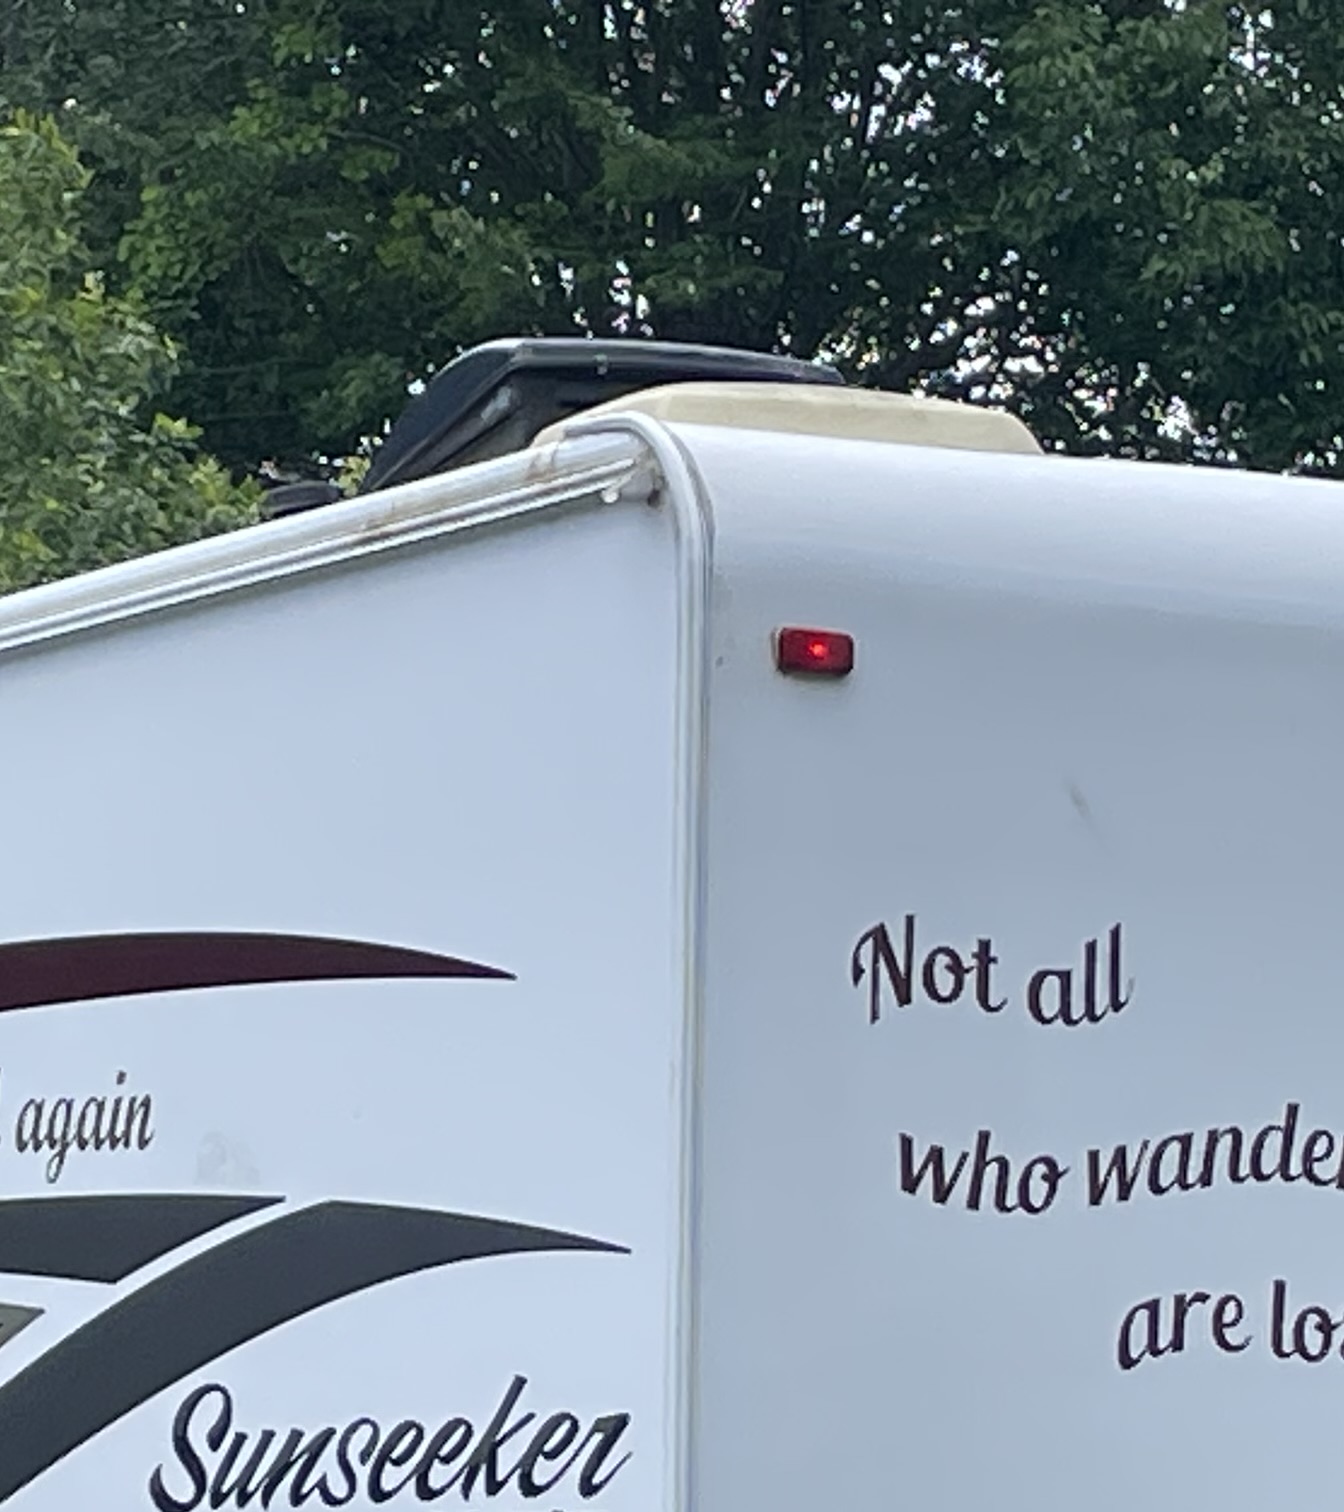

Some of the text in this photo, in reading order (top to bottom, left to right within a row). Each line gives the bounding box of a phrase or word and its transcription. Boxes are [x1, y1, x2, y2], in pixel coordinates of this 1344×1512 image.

[851, 914, 1134, 1027] Not all
[15, 1070, 154, 1184] again
[898, 1129, 1070, 1216] who
[1117, 1291, 1252, 1371] are
